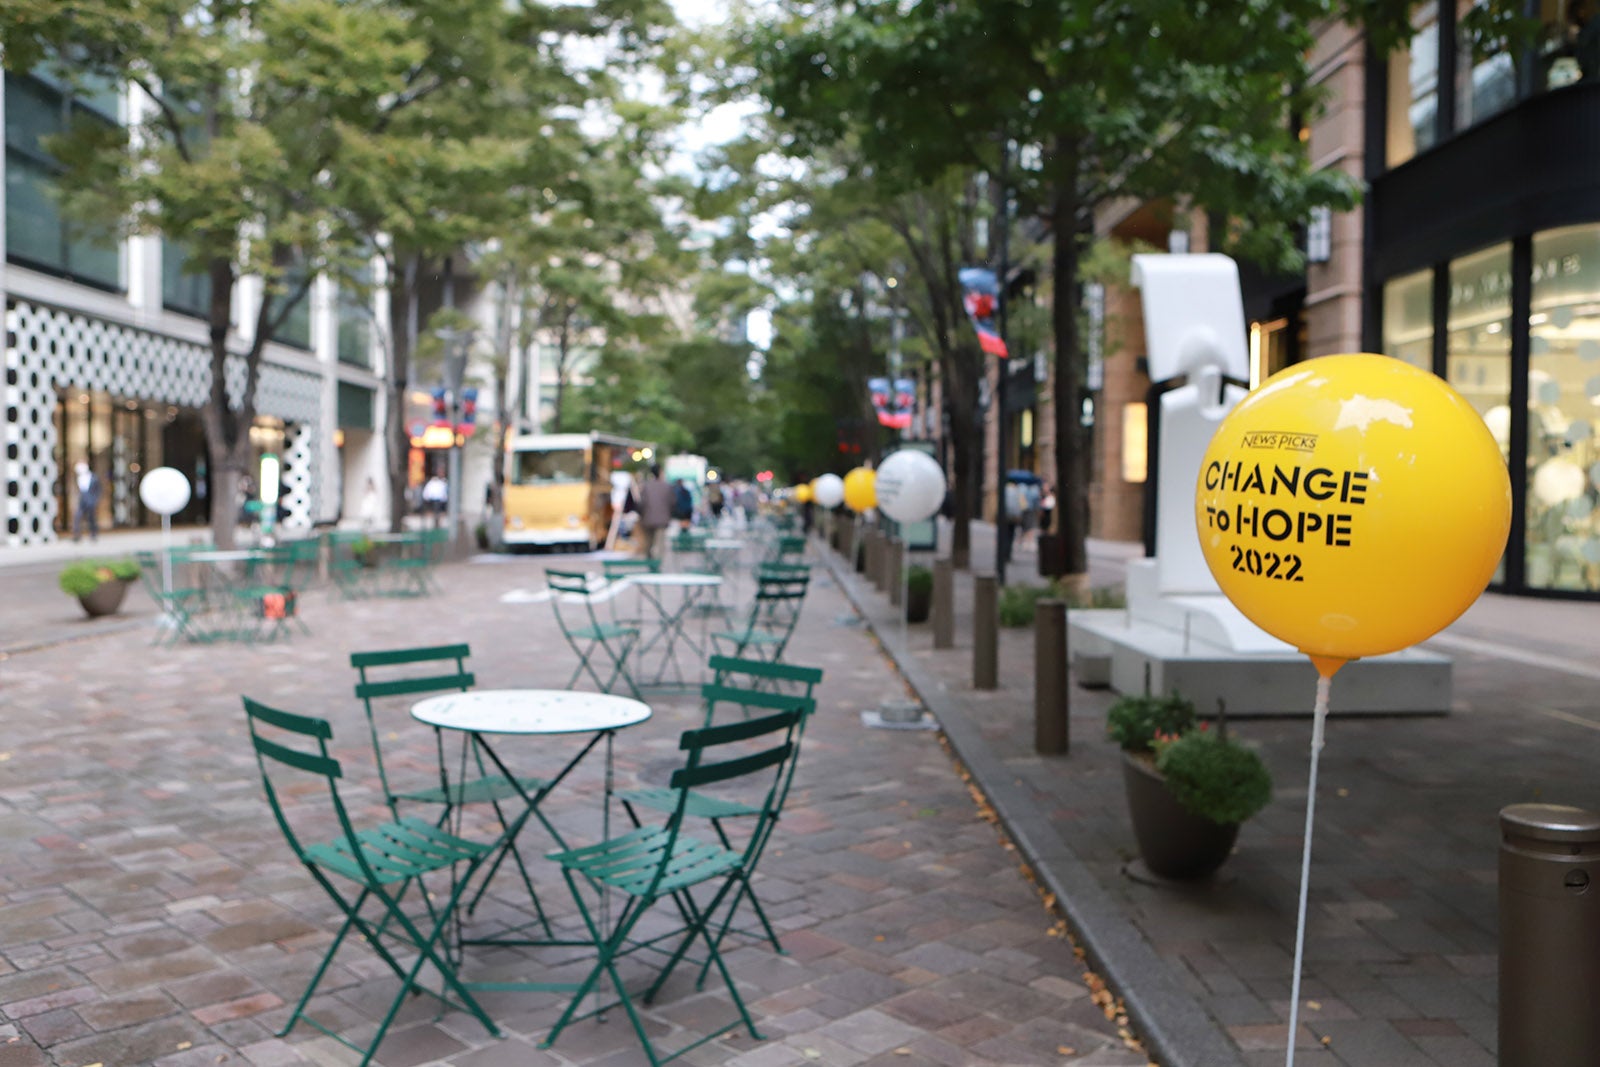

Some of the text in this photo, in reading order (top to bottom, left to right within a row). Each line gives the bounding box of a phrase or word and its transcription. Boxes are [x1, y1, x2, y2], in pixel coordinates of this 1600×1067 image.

[1205, 460, 1368, 504] CHANGE
[1236, 504, 1352, 546] HOPE
[1230, 544, 1304, 582] 2022
